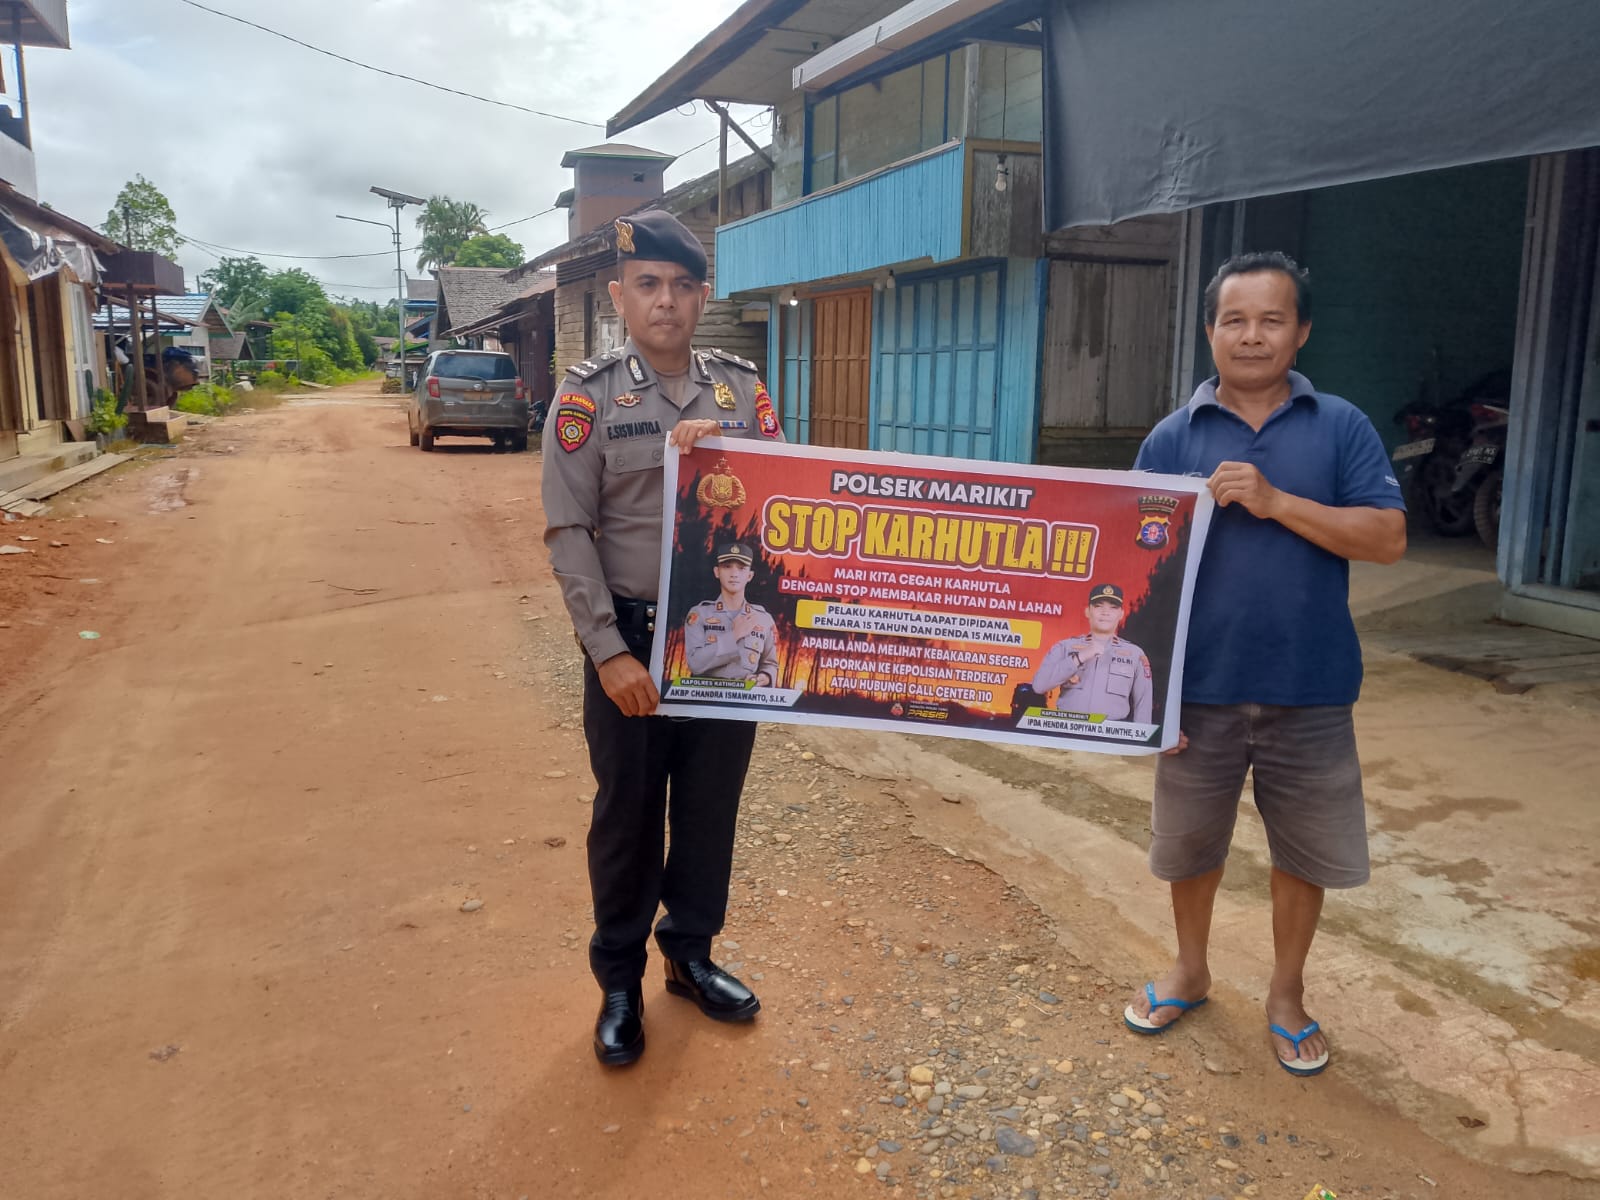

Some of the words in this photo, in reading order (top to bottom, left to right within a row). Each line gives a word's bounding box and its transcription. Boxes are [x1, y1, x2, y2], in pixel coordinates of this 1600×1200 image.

[833, 473, 923, 498] POLSEK
[929, 482, 1033, 508] MARIKIT
[768, 502, 858, 551] STOP
[864, 512, 1044, 569] KARHUTLA
[1051, 529, 1092, 573] !!!
[834, 568, 866, 581] MARI
[869, 570, 896, 584] KITA
[899, 573, 942, 588] CEGAH
[945, 578, 1011, 594] KARHUTLA
[782, 580, 833, 594] DENGAN
[835, 583, 868, 597] STOP
[870, 587, 942, 604] MEMBAKAR
[945, 594, 987, 608] HUTAN
[990, 598, 1017, 610] DAN
[1019, 600, 1062, 616] LAHAN
[814, 616, 860, 629] PENJARA
[862, 619, 872, 629] 15
[874, 620, 908, 633] TAHUN
[911, 624, 931, 635] DAN
[934, 627, 969, 640] DENDA
[971, 630, 980, 640] 15
[983, 631, 1021, 644] MILYAR
[828, 606, 865, 617] PELAKU
[868, 607, 921, 621] KARHUTLA
[924, 614, 959, 627] DAPAT
[960, 617, 1009, 631] DIPIDANA
[750, 631, 764, 640] OLRI
[802, 637, 845, 651] APABILA
[847, 640, 875, 654] ANDA
[878, 643, 922, 658] MELIHAT
[924, 648, 987, 665] KEBAKARAN
[988, 654, 1029, 668] SEGERA
[1111, 656, 1134, 665] POLRI
[820, 658, 875, 673] LAPORKAN
[878, 662, 891, 673] KE
[892, 663, 953, 680] KEPOLISIAN
[955, 669, 1007, 685] TERDEKAT
[670, 689, 689, 697] AKBP
[691, 690, 723, 699] CHANDRA
[725, 692, 768, 703] ISMAWANTO,
[831, 677, 857, 690] ATAU
[859, 679, 906, 694] HUBUNGI
[908, 683, 933, 696] CALL
[936, 687, 976, 701] CENTER
[978, 690, 992, 702] 110
[1027, 718, 1042, 728] IPDA
[1043, 720, 1068, 730] HENDRA
[1106, 728, 1133, 738] MUNTHE,
